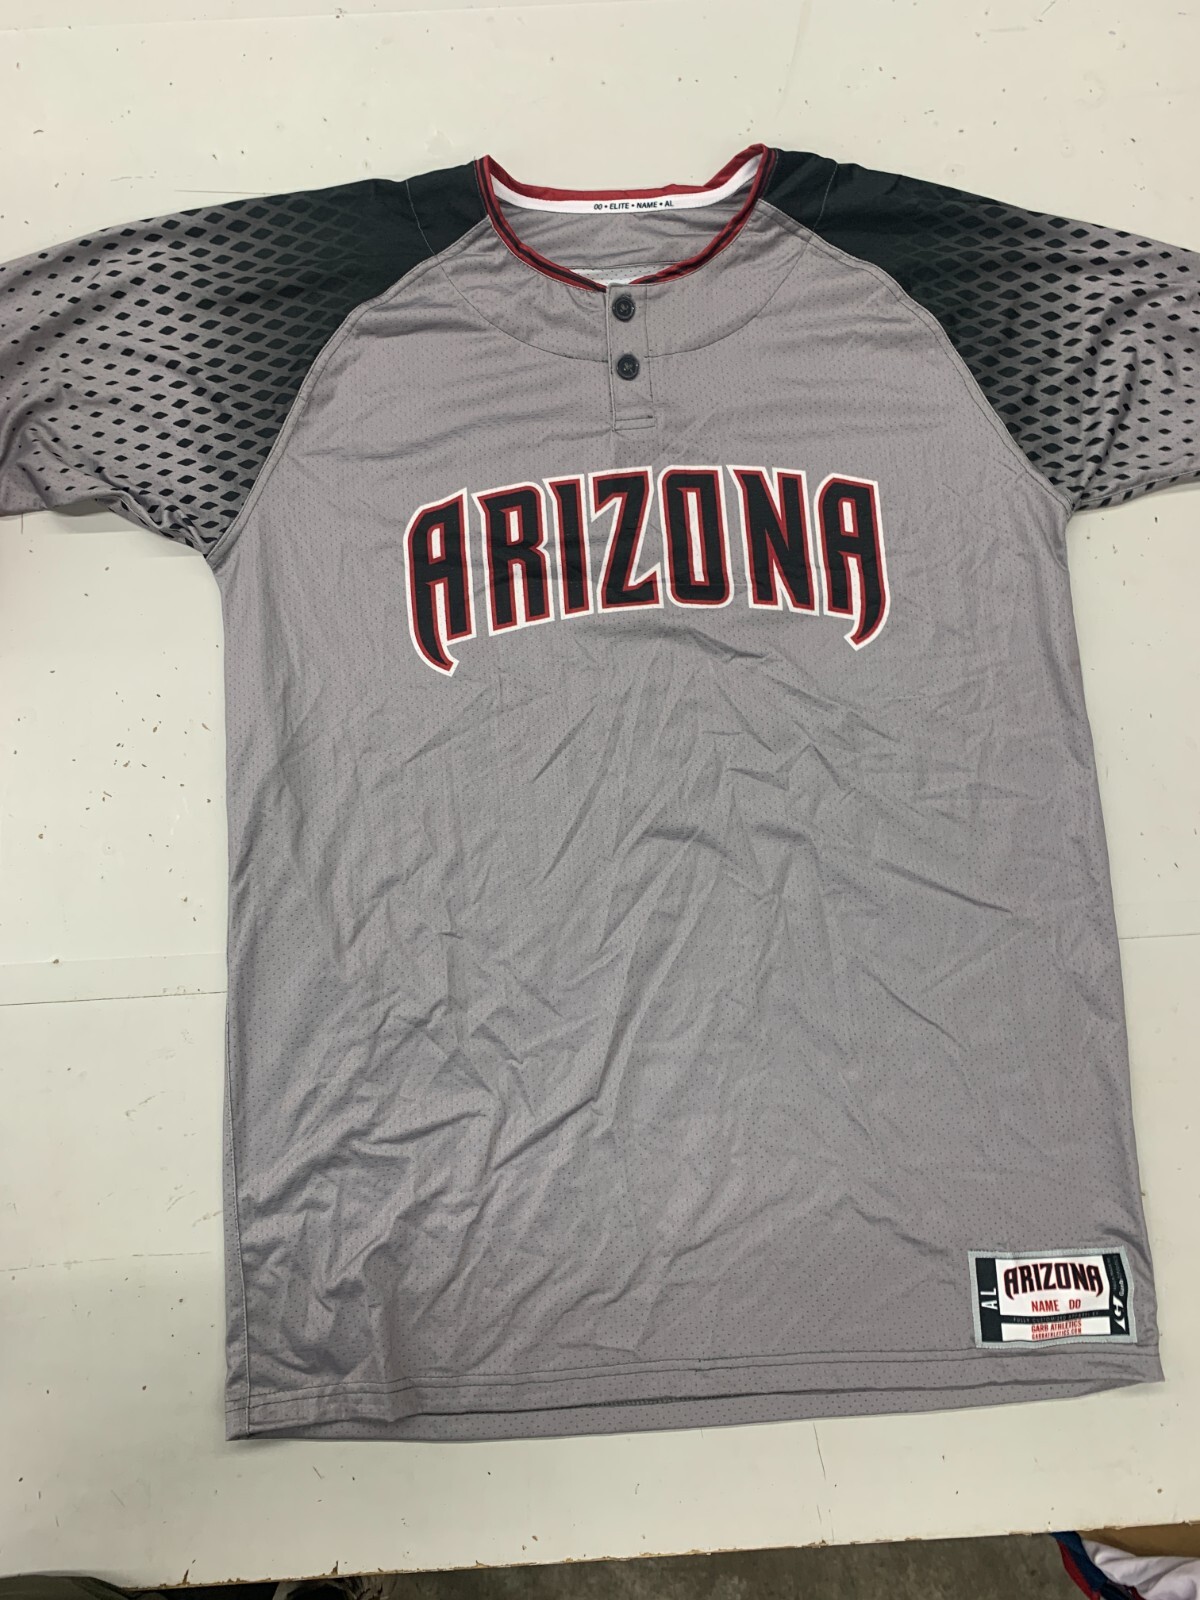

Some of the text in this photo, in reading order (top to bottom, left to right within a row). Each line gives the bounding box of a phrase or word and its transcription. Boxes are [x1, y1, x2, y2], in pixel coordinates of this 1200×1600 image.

[609, 202, 630, 210] ELITE
[636, 201, 658, 209] NAME
[402, 464, 891, 678] ARIZONA
[1003, 1262, 1104, 1300] ARIZONA
[980, 1287, 998, 1310] AL
[1031, 1299, 1060, 1313] NAME
[1031, 1318, 1082, 1334] GARB ATHLETICS
